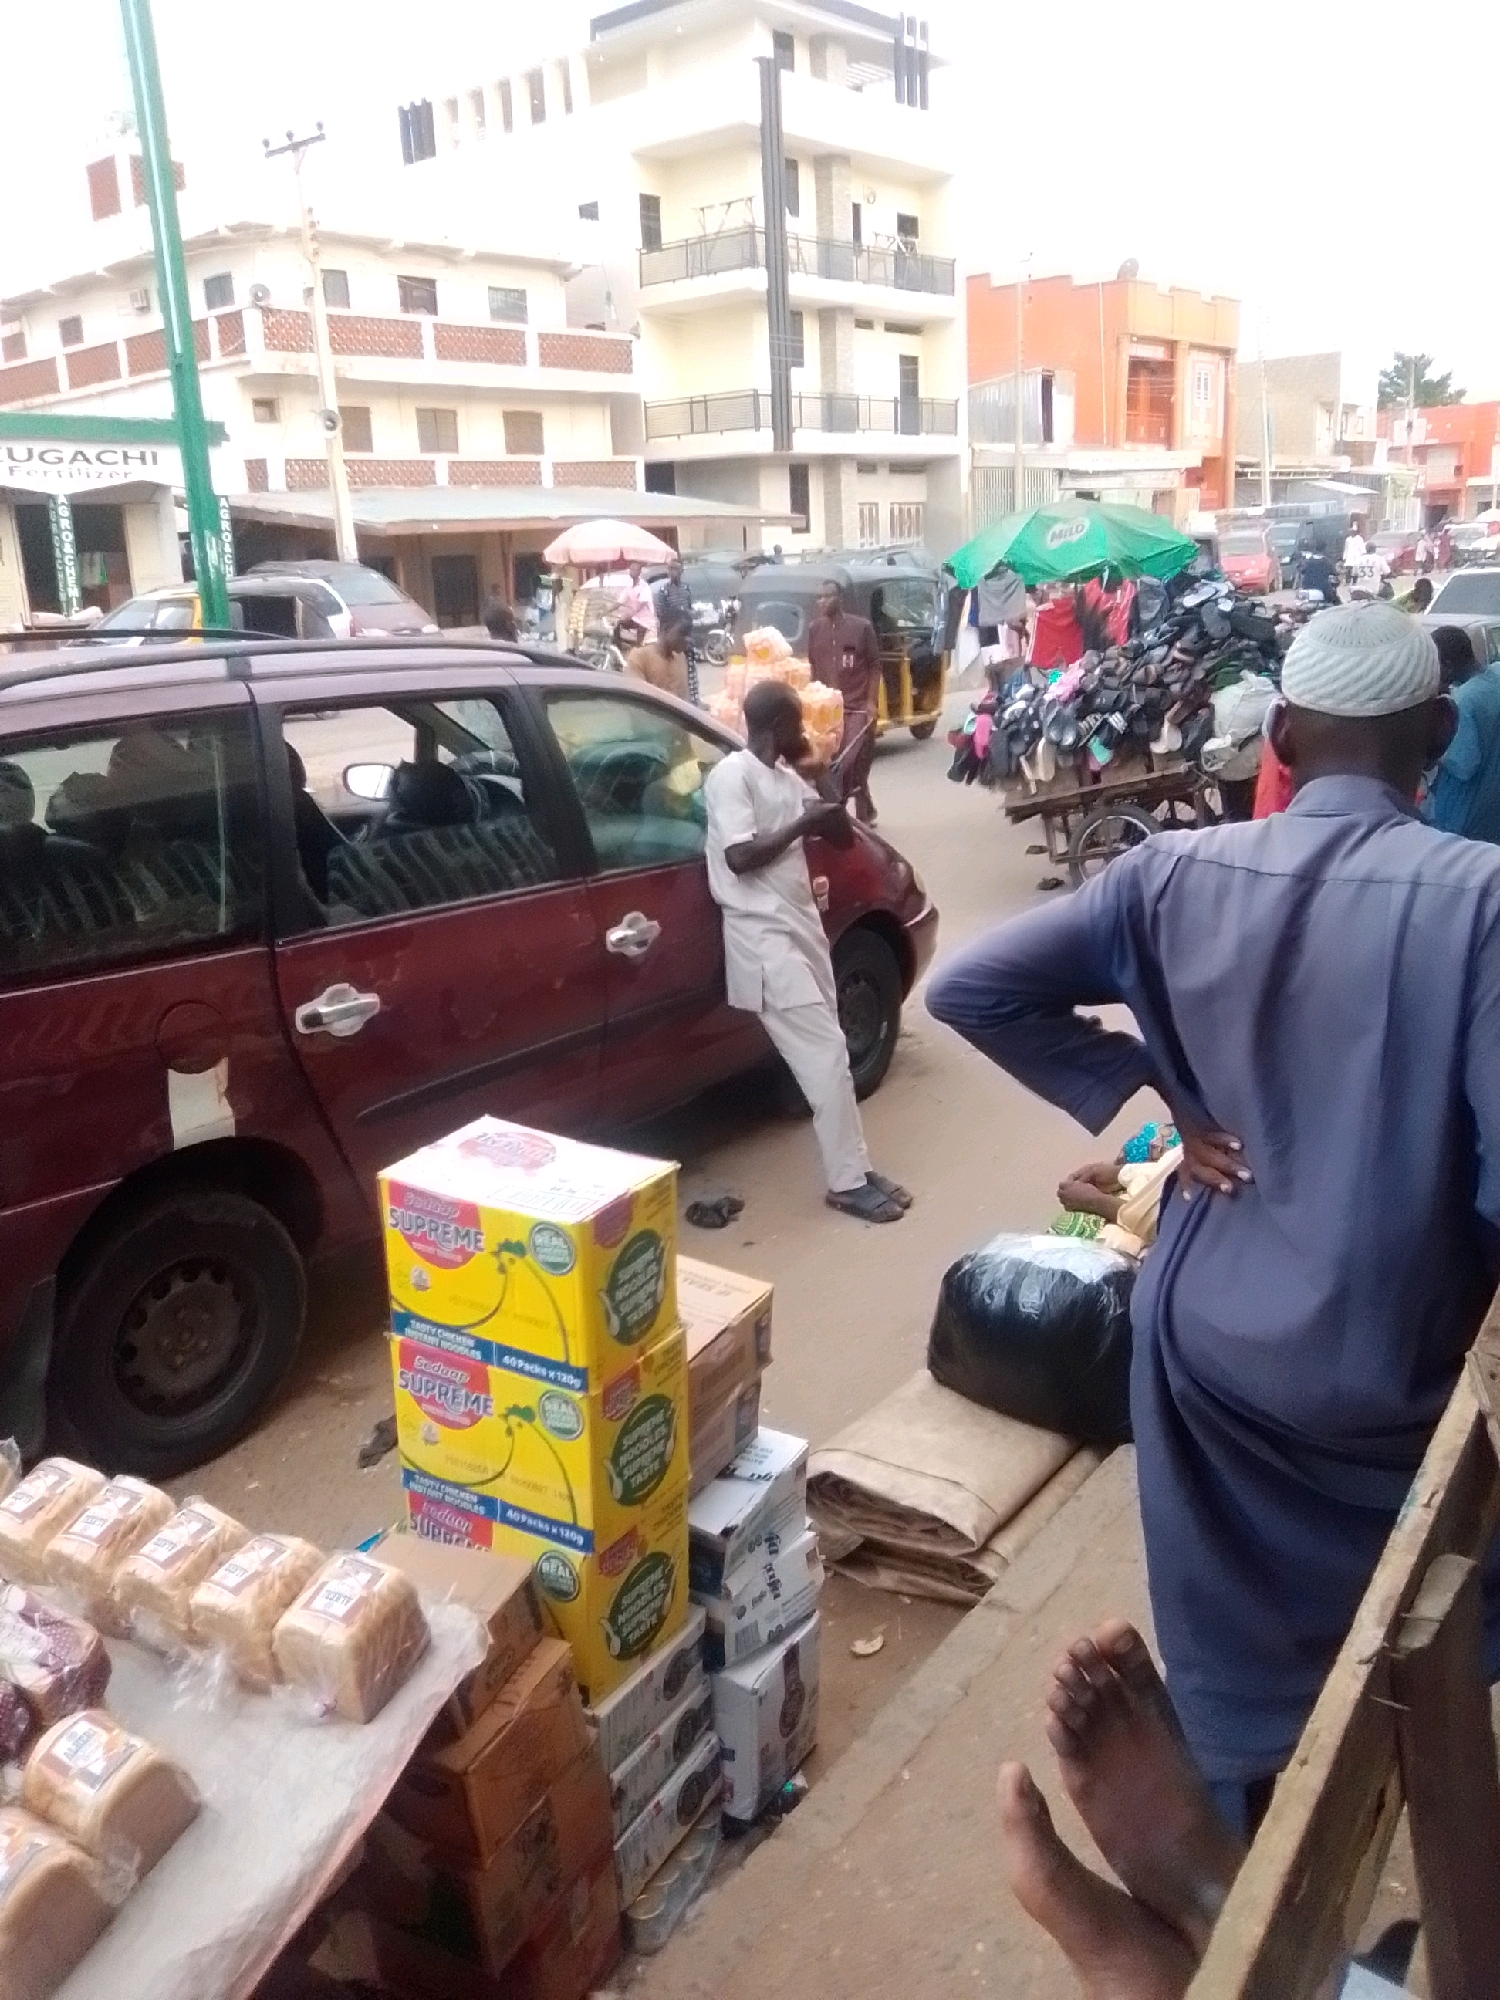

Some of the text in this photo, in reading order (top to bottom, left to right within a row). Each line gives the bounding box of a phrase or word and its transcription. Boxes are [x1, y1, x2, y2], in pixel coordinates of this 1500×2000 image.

[0, 446, 158, 466] UGACHI
[1358, 565, 1375, 578] 33
[389, 1206, 486, 1253] SUPREME
[413, 1355, 470, 1384] Sedaap
[398, 1369, 494, 1416] SUPREME
